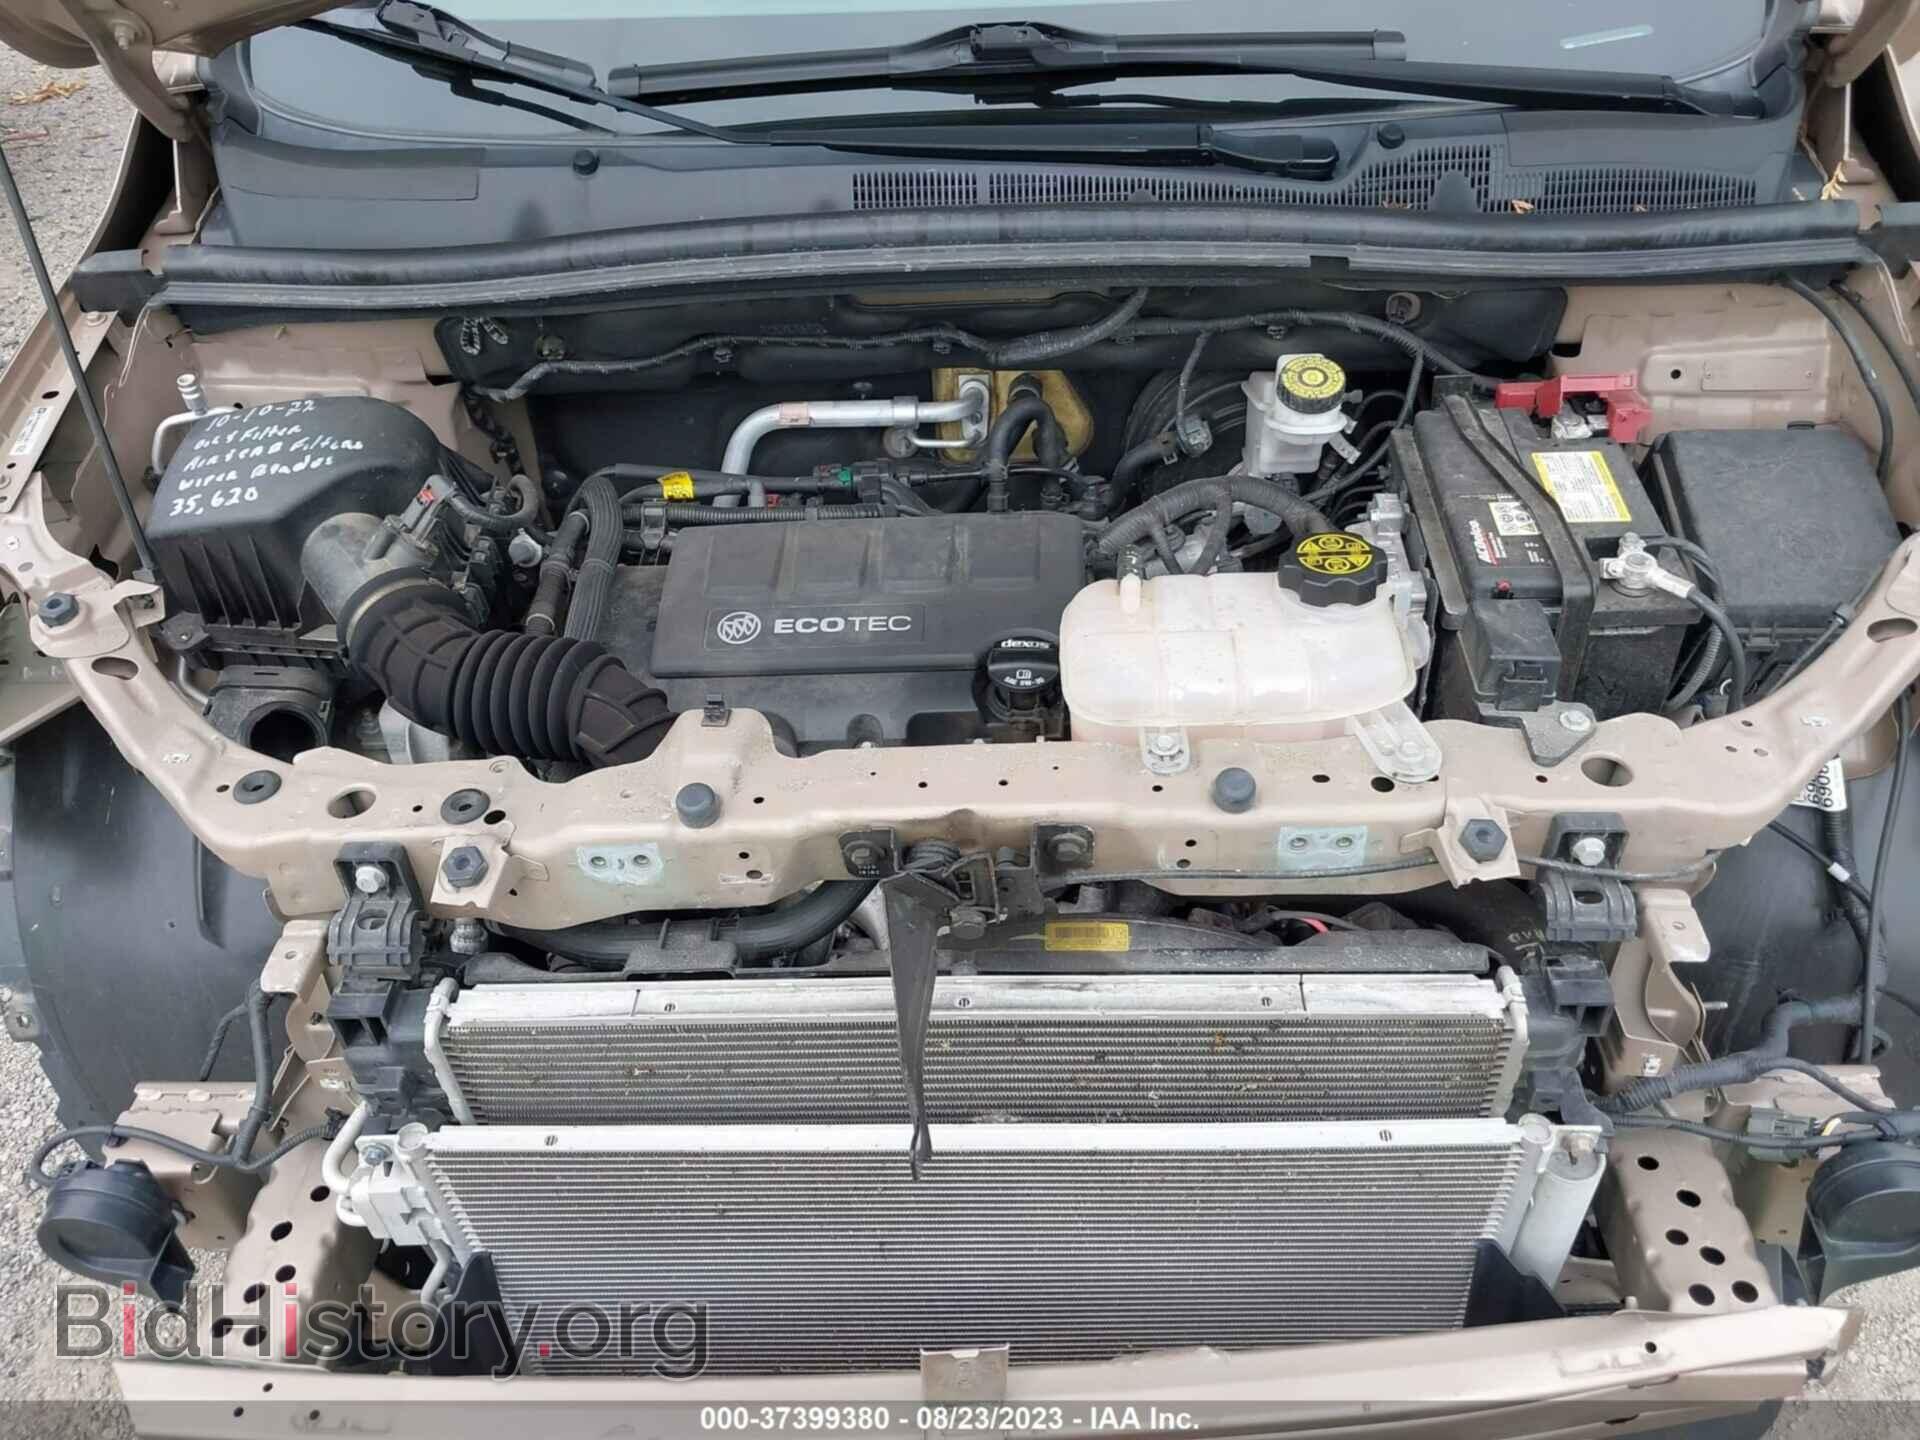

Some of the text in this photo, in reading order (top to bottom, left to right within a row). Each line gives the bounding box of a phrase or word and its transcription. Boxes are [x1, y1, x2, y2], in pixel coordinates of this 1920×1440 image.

[169, 486, 259, 517] 35,620
[773, 615, 912, 634] ECOTEC
[1000, 638, 1050, 649] dexos
